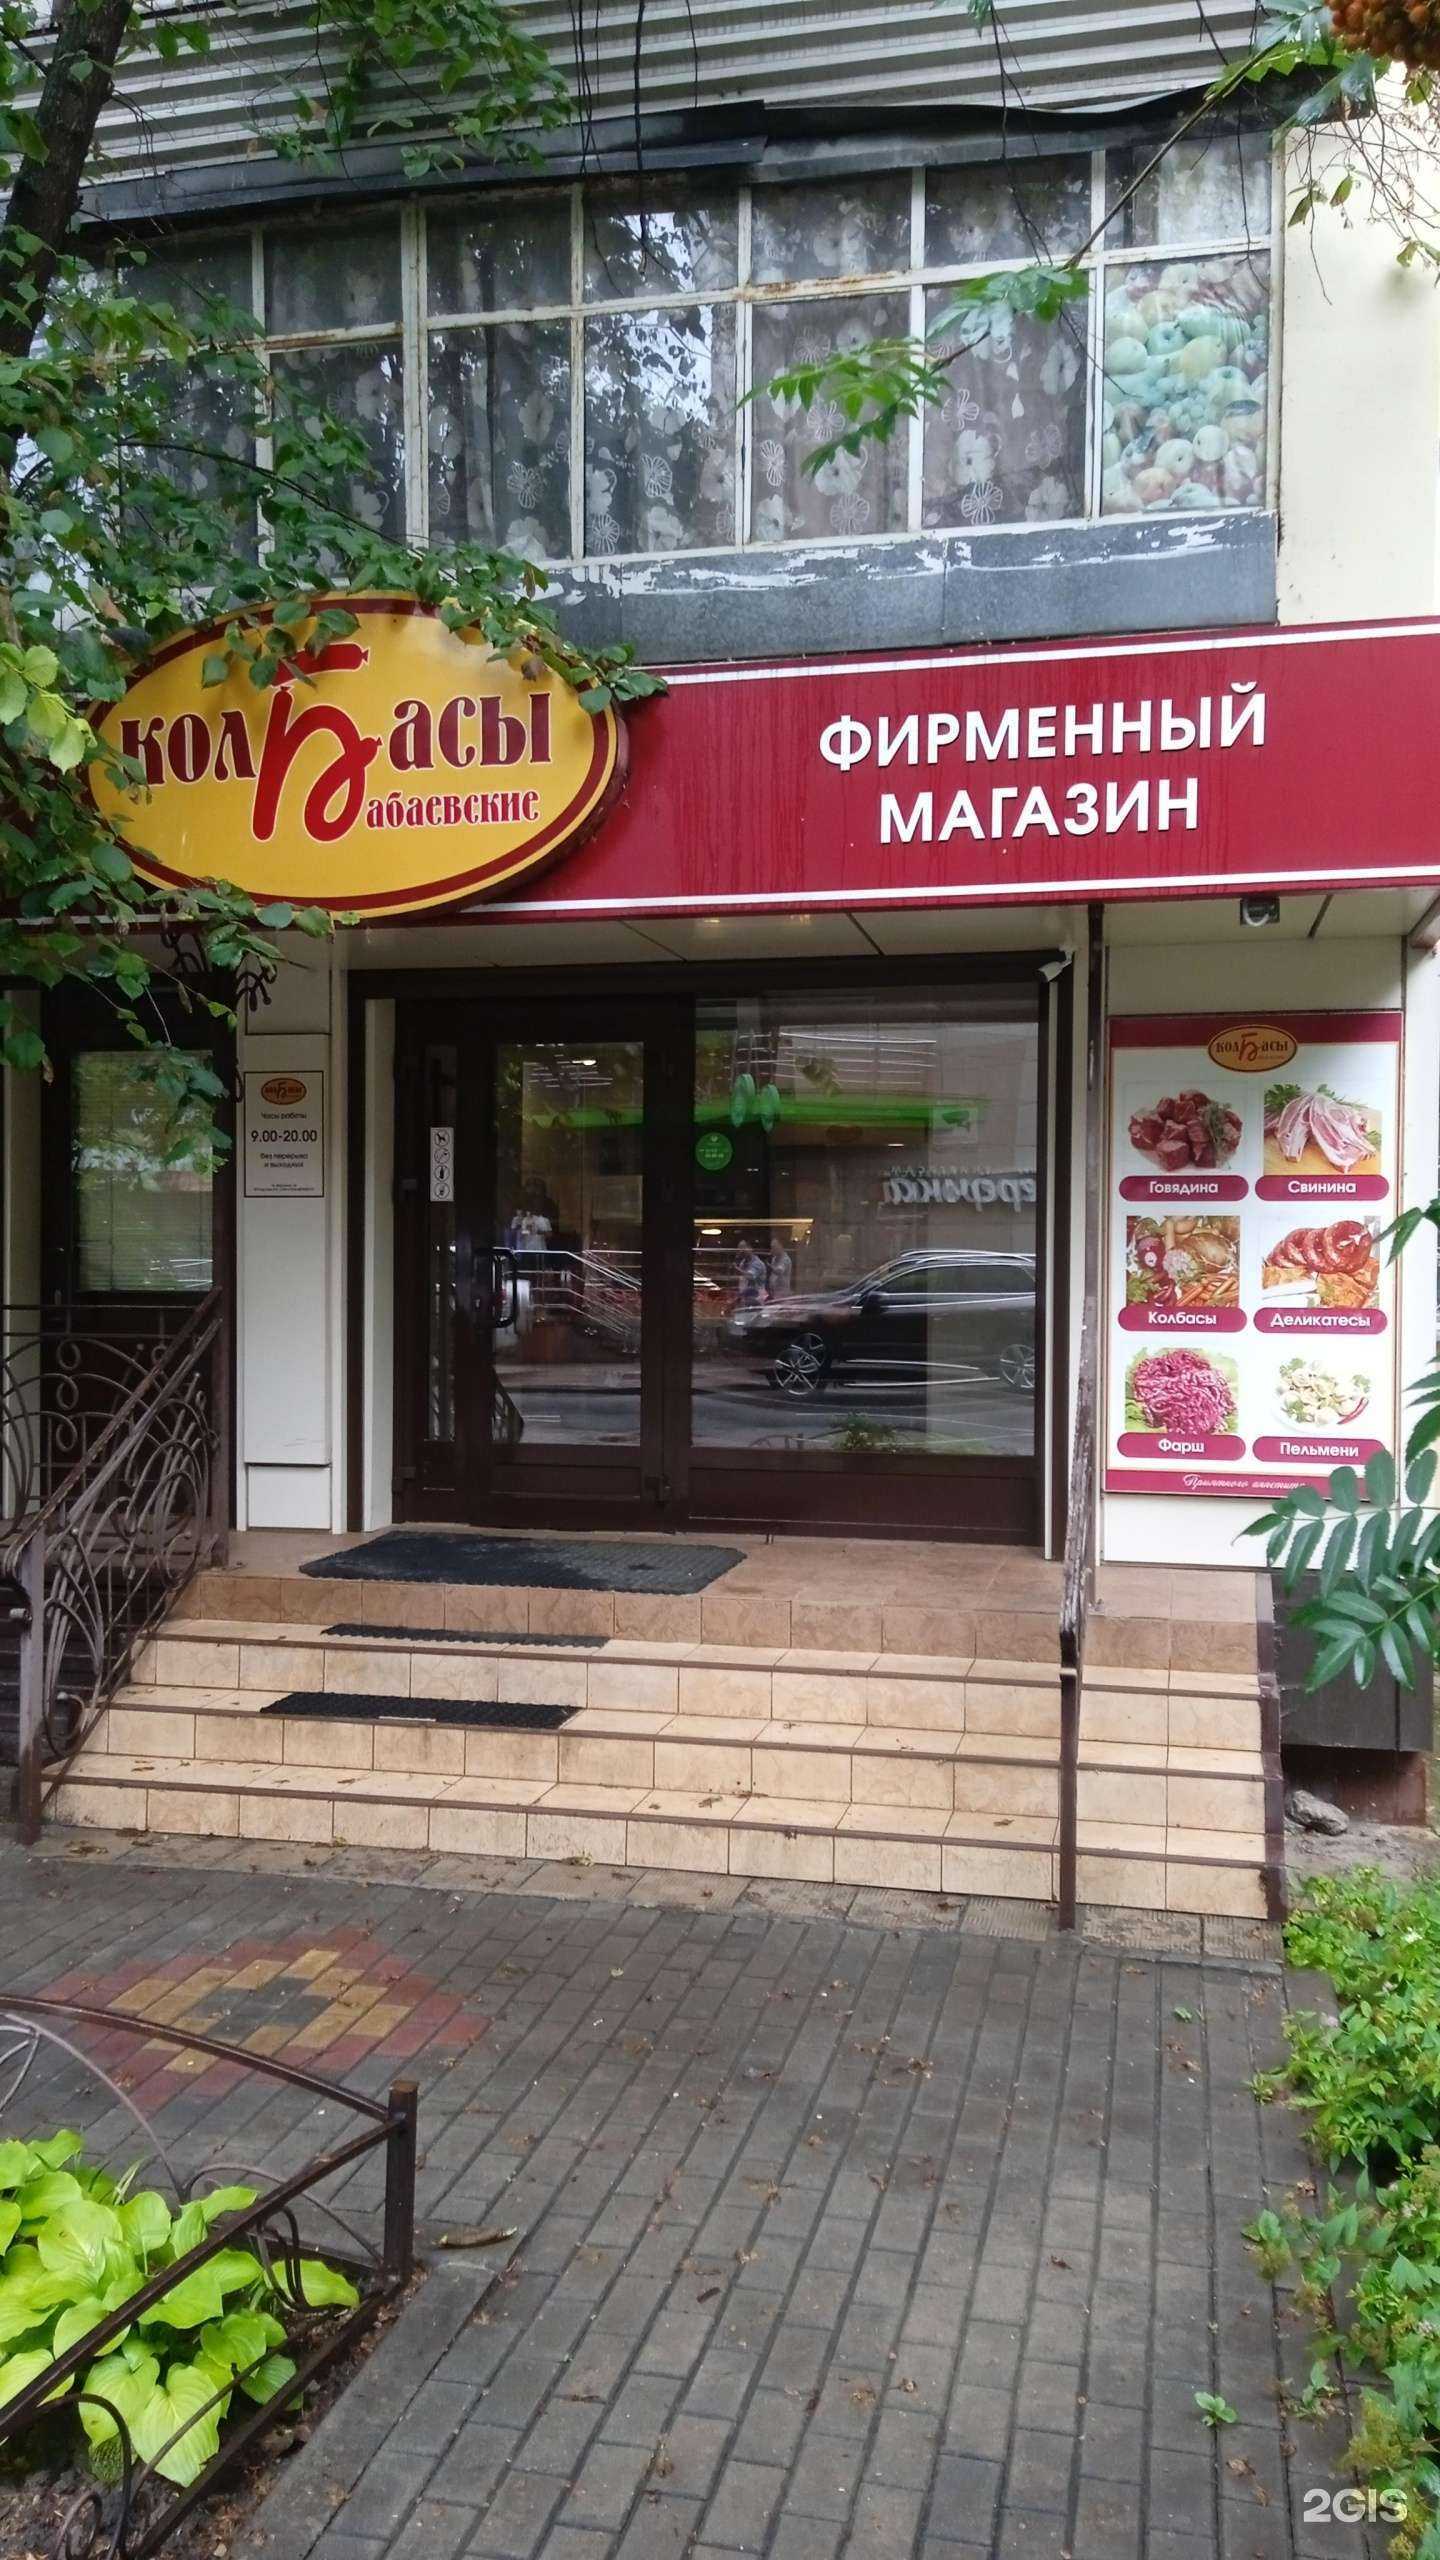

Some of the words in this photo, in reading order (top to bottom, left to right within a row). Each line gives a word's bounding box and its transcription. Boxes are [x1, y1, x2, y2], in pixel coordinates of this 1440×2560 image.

[818, 680, 1267, 771] ФИРМЕННЫЙ
[879, 777, 1199, 845] МАГАЗИН
[251, 1130, 318, 1142] 9.00-20.00
[1149, 1181, 1218, 1196] Говядина
[1288, 1180, 1357, 1194] Свинина
[1148, 1311, 1217, 1326] Колбасы
[1270, 1312, 1371, 1328] Деликатесы
[1158, 1437, 1204, 1453] Фарш
[1279, 1441, 1359, 1457] Пельмени
